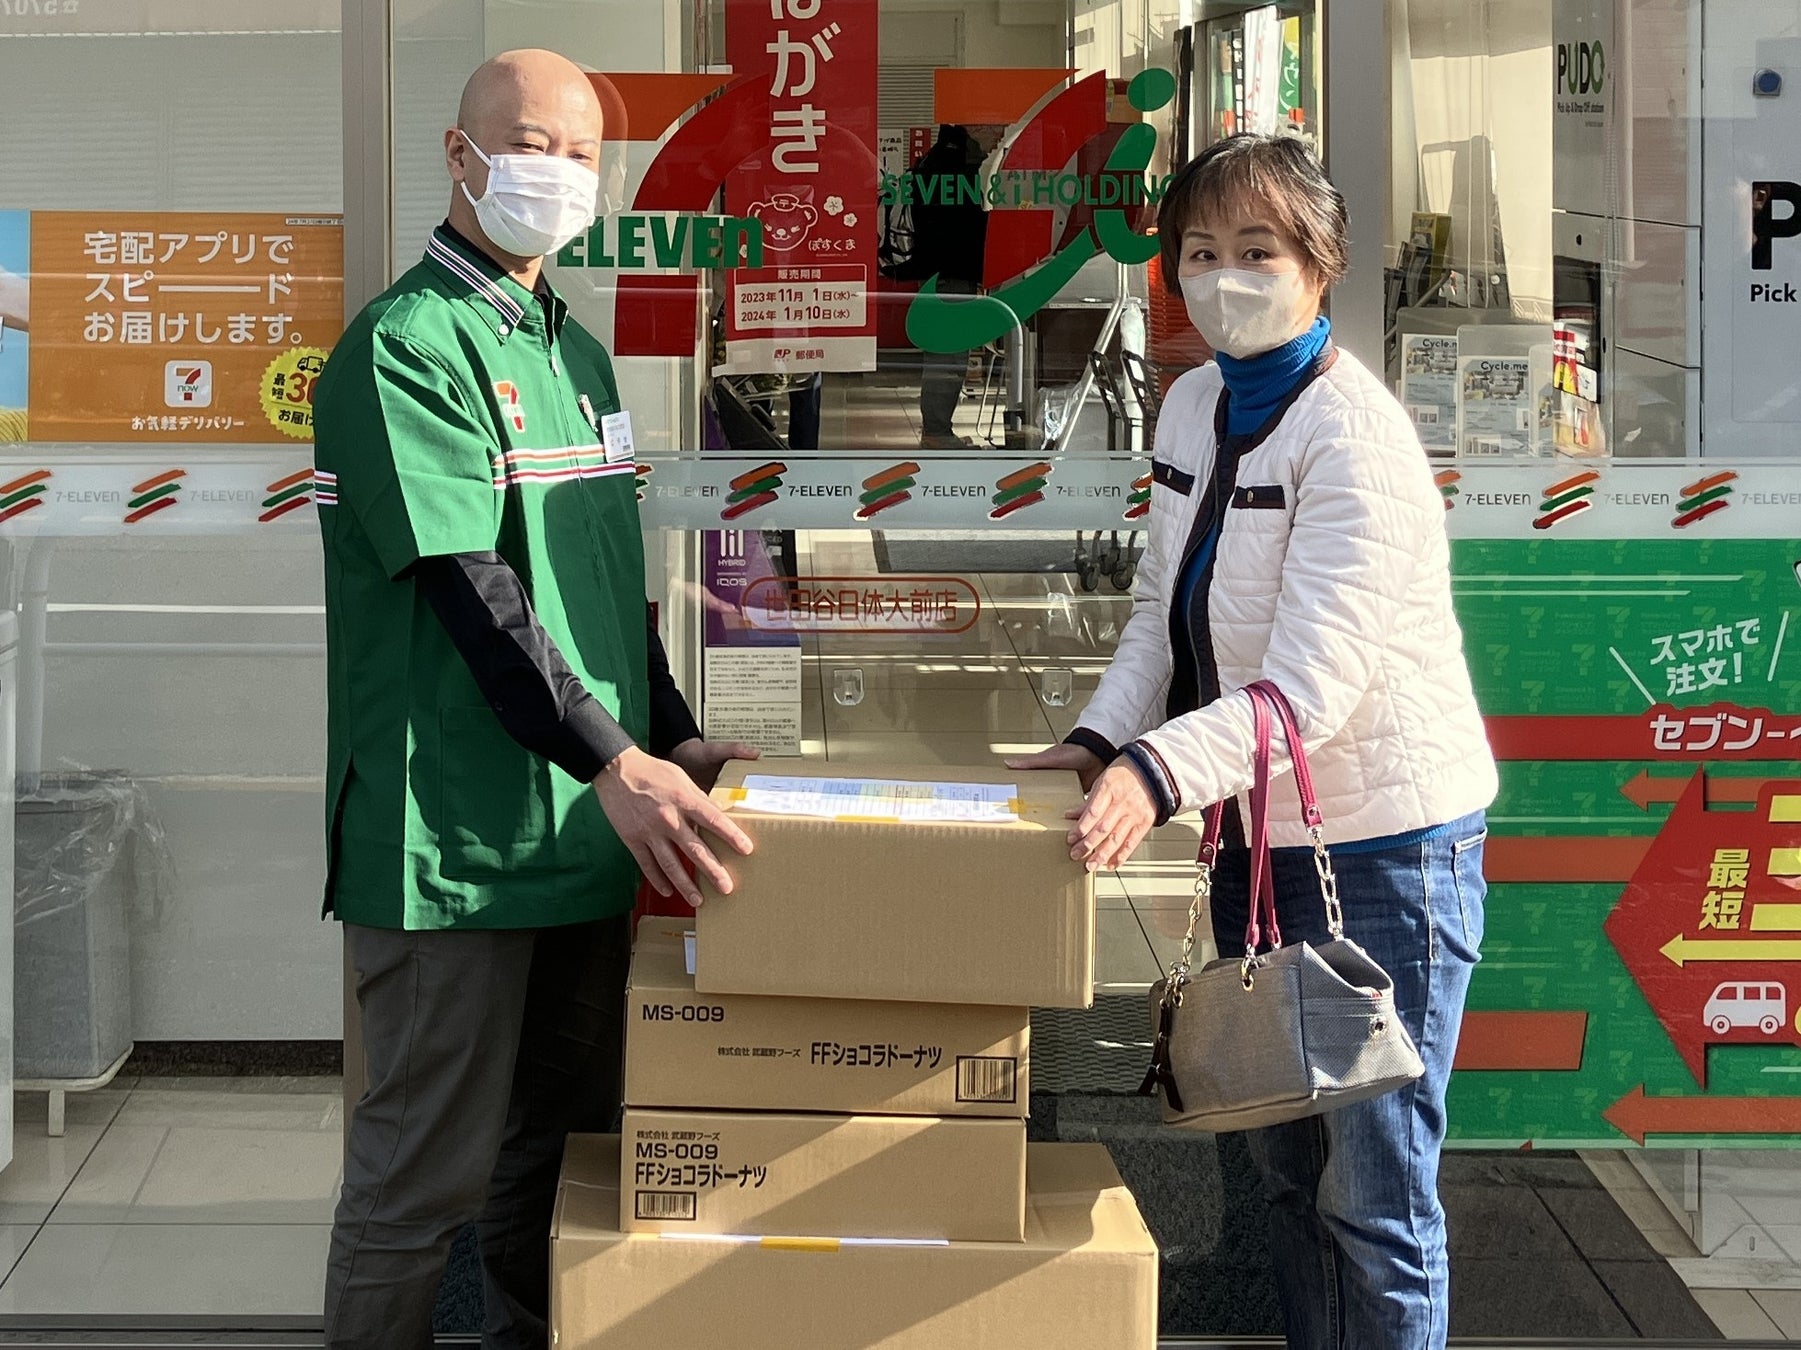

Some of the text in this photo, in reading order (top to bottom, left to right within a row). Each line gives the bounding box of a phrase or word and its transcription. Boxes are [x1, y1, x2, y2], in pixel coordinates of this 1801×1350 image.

[1558, 40, 1605, 95] PUDO
[882, 174, 981, 206] SEVEN
[987, 174, 1007, 206] &
[84, 230, 294, 265] 宅配アプリで
[777, 268, 822, 280] 販売期間
[740, 288, 804, 303] 2023年11月
[1750, 283, 1797, 302] Pick
[741, 310, 777, 322] 2024年
[84, 311, 302, 344] お届けします。
[1480, 361, 1528, 371] Cycle.me
[271, 373, 286, 400] 最短
[131, 415, 245, 431] お気軽デリバリー
[718, 559, 746, 567] HYBRID
[717, 577, 747, 587] IQOS
[765, 589, 958, 622] 世田谷日体大前店
[1650, 618, 1761, 665] スマホで
[1699, 849, 1750, 930] 最短
[642, 1004, 725, 1022] MS-009
[717, 1047, 750, 1057] 株式会社
[811, 1042, 943, 1069] FFショコラドーナツ
[637, 1130, 669, 1140] 株式会社
[636, 1142, 719, 1160] MS-009
[635, 1162, 767, 1189] FFショコラドーナツ
